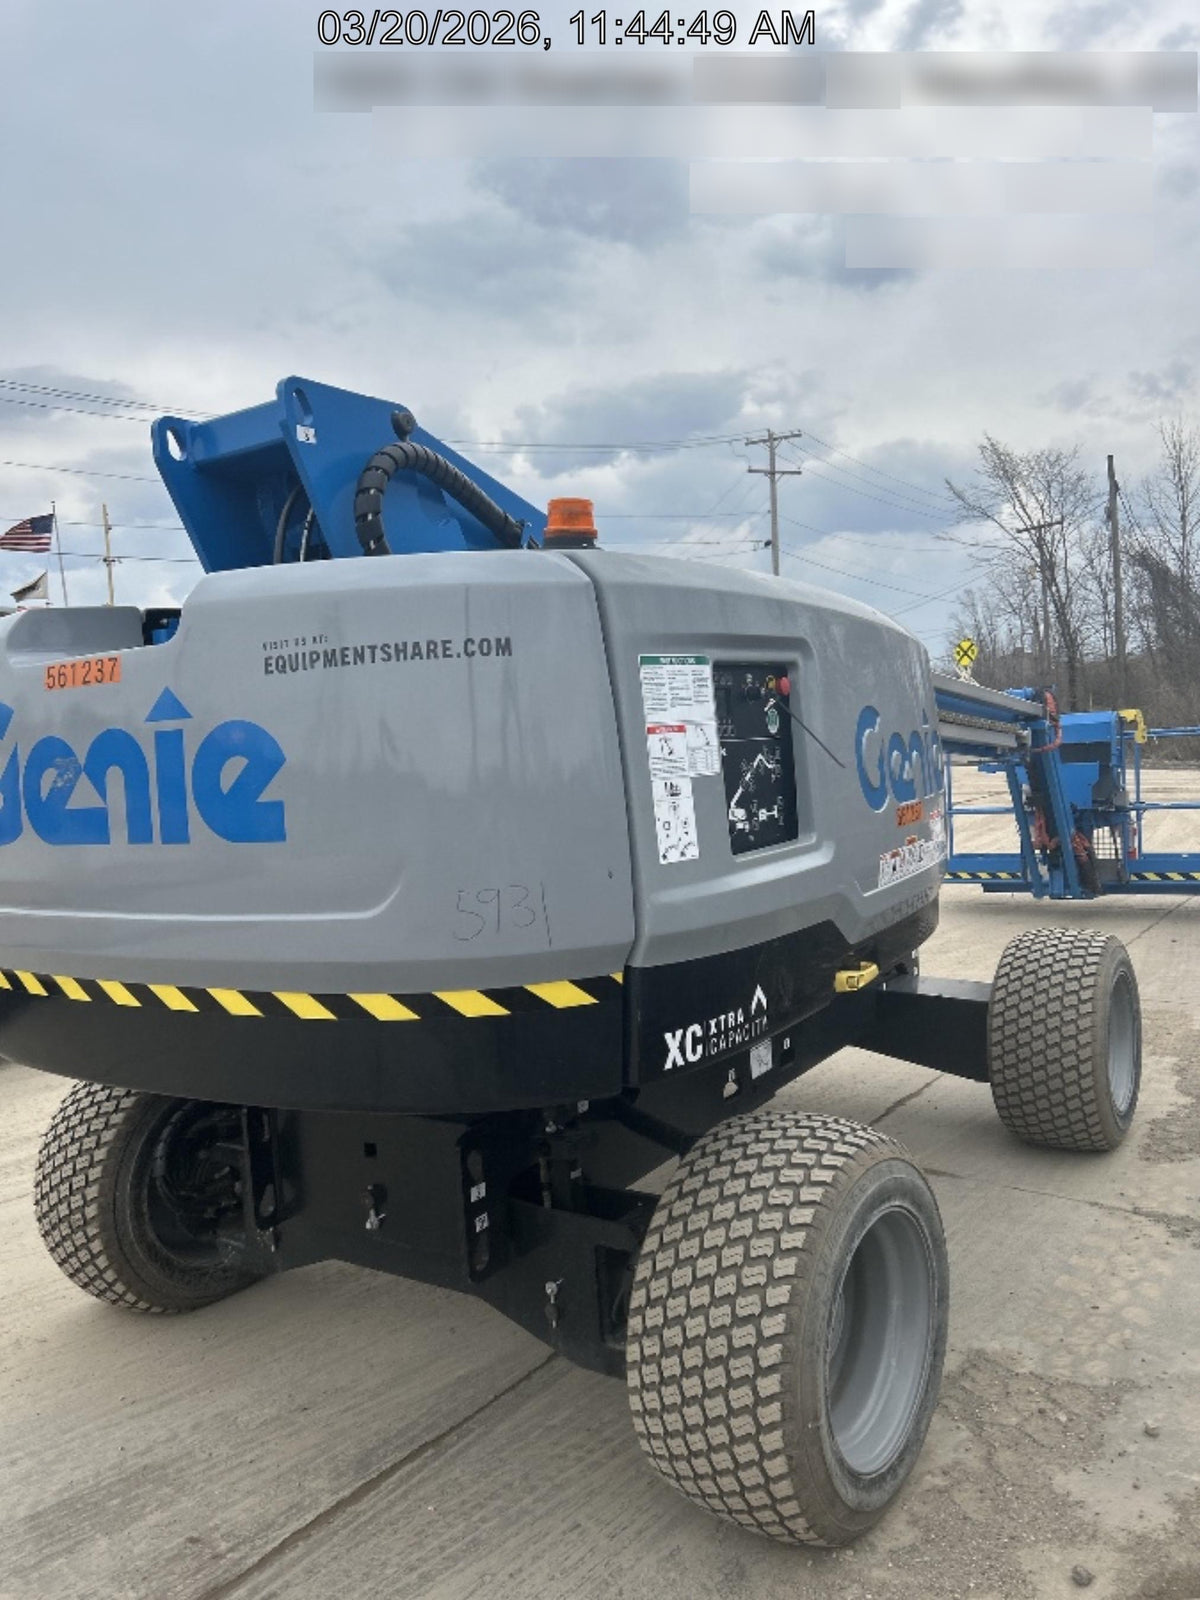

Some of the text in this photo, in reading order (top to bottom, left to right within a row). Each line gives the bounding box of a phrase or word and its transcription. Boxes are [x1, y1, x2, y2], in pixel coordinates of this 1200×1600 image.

[45, 657, 118, 690] 561237
[264, 637, 513, 676] EQUIPMENTSHARE.COM
[0, 687, 286, 845] enie
[708, 1007, 745, 1036] XTRA
[710, 1014, 769, 1056] CAPACITY
[663, 1023, 703, 1071] XC
